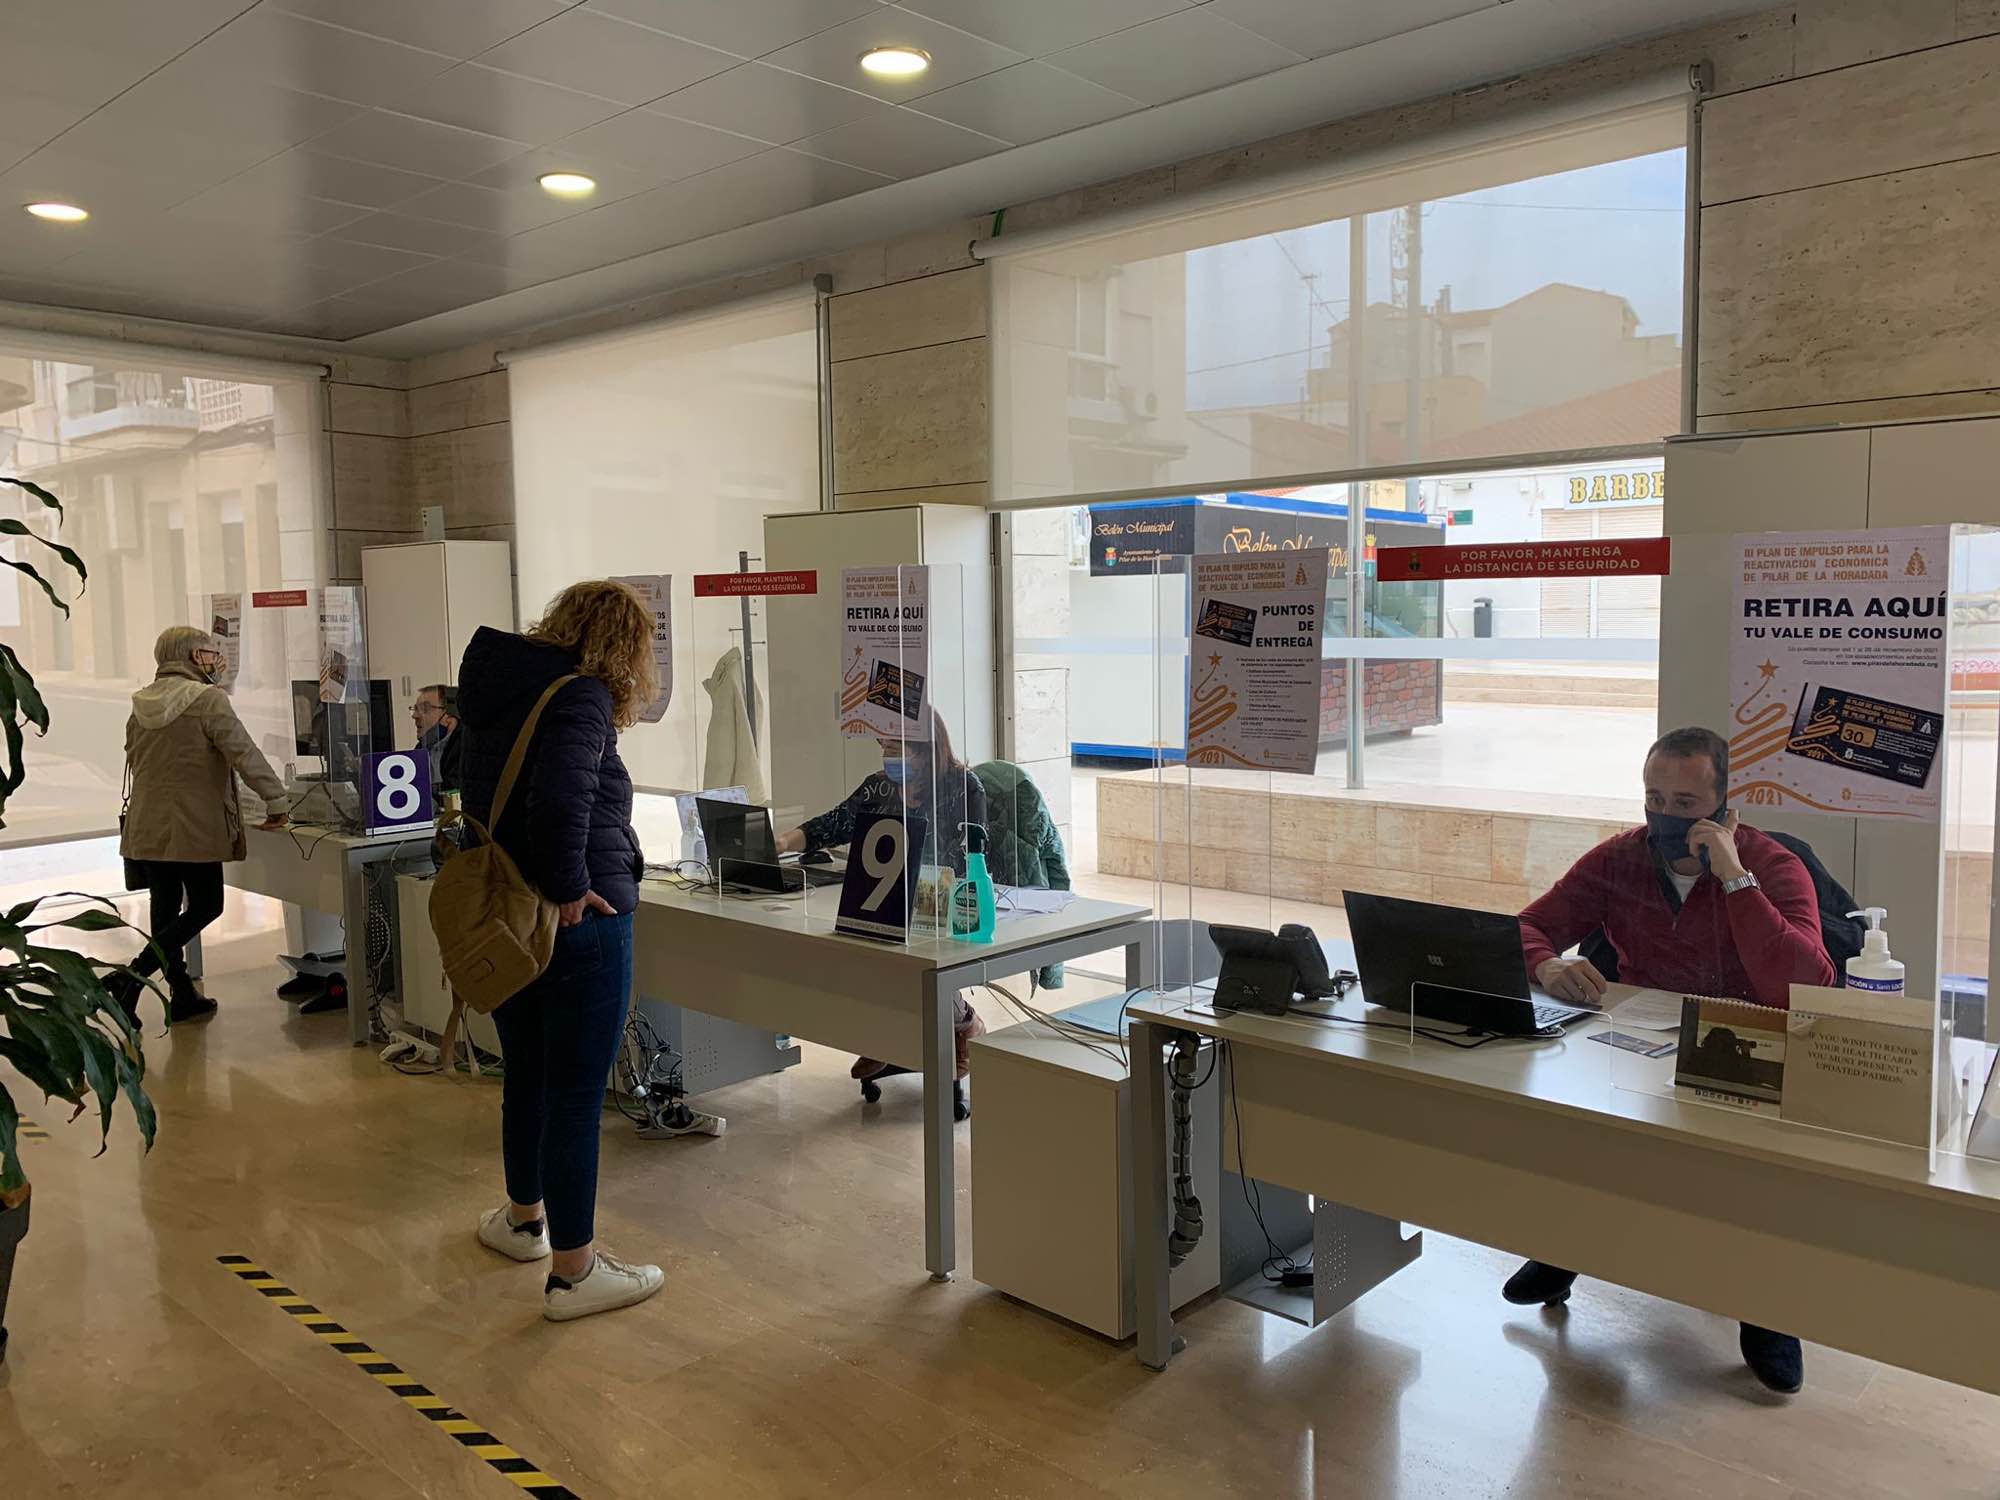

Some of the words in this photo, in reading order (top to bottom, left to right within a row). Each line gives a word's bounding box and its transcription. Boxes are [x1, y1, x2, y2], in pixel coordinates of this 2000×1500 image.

[1126, 520, 1175, 536] Municipal
[1460, 551, 1488, 561] POR
[1491, 549, 1537, 560] FAVOR,
[1541, 546, 1622, 558] MANTENGA
[1756, 547, 1781, 558] PLAN
[1784, 547, 1797, 557] DE
[1799, 545, 1844, 557] IMPULSO
[1847, 544, 1874, 555] PARA
[1876, 544, 1889, 555] LA
[1444, 563, 1461, 574] LA
[1464, 562, 1534, 573] DISTANCIA
[1537, 561, 1555, 571] DE
[1559, 559, 1640, 570] SEGURIDAD
[764, 575, 798, 583] MANTENGA
[1743, 572, 1756, 582] DE
[1762, 572, 1790, 582] PILAR
[1795, 571, 1809, 581] DE
[1815, 570, 1828, 581] LA
[1833, 570, 1889, 581] HORADADA
[732, 584, 761, 592] DISTANCIA
[771, 583, 805, 591] SEGURIDAD
[847, 607, 890, 619] RETIRA
[893, 603, 924, 620] AQUÍ
[1262, 605, 1315, 616] PUNTOS
[1743, 597, 1854, 618] RETIRA
[1864, 590, 1947, 619] AQUÍ
[1298, 620, 1315, 632] DE
[1743, 627, 1766, 639] TU
[1771, 627, 1814, 639] VALE
[1819, 627, 1843, 639] DE
[1848, 627, 1943, 639] CONSUMO
[1256, 637, 1313, 648] ENTREGA
[1843, 728, 1864, 744] 30
[1200, 751, 1226, 764] 2021
[377, 754, 420, 820] 8
[1744, 788, 1783, 806] 2021
[861, 818, 910, 912] 9
[1819, 1032, 1840, 1042] YOU
[1841, 1037, 1867, 1049] WISH
[1869, 1040, 1882, 1049] TO
[1883, 1043, 1920, 1056] RENEW
[1814, 1042, 1840, 1052] YOUR
[1842, 1046, 1882, 1060] HEALTH
[1883, 1054, 1913, 1065] CARD
[1815, 1061, 1861, 1077] UPDATED
[1829, 1055, 1856, 1066] MUST
[1858, 1059, 1900, 1074] PRESENT
[1903, 1067, 1918, 1077] AN
